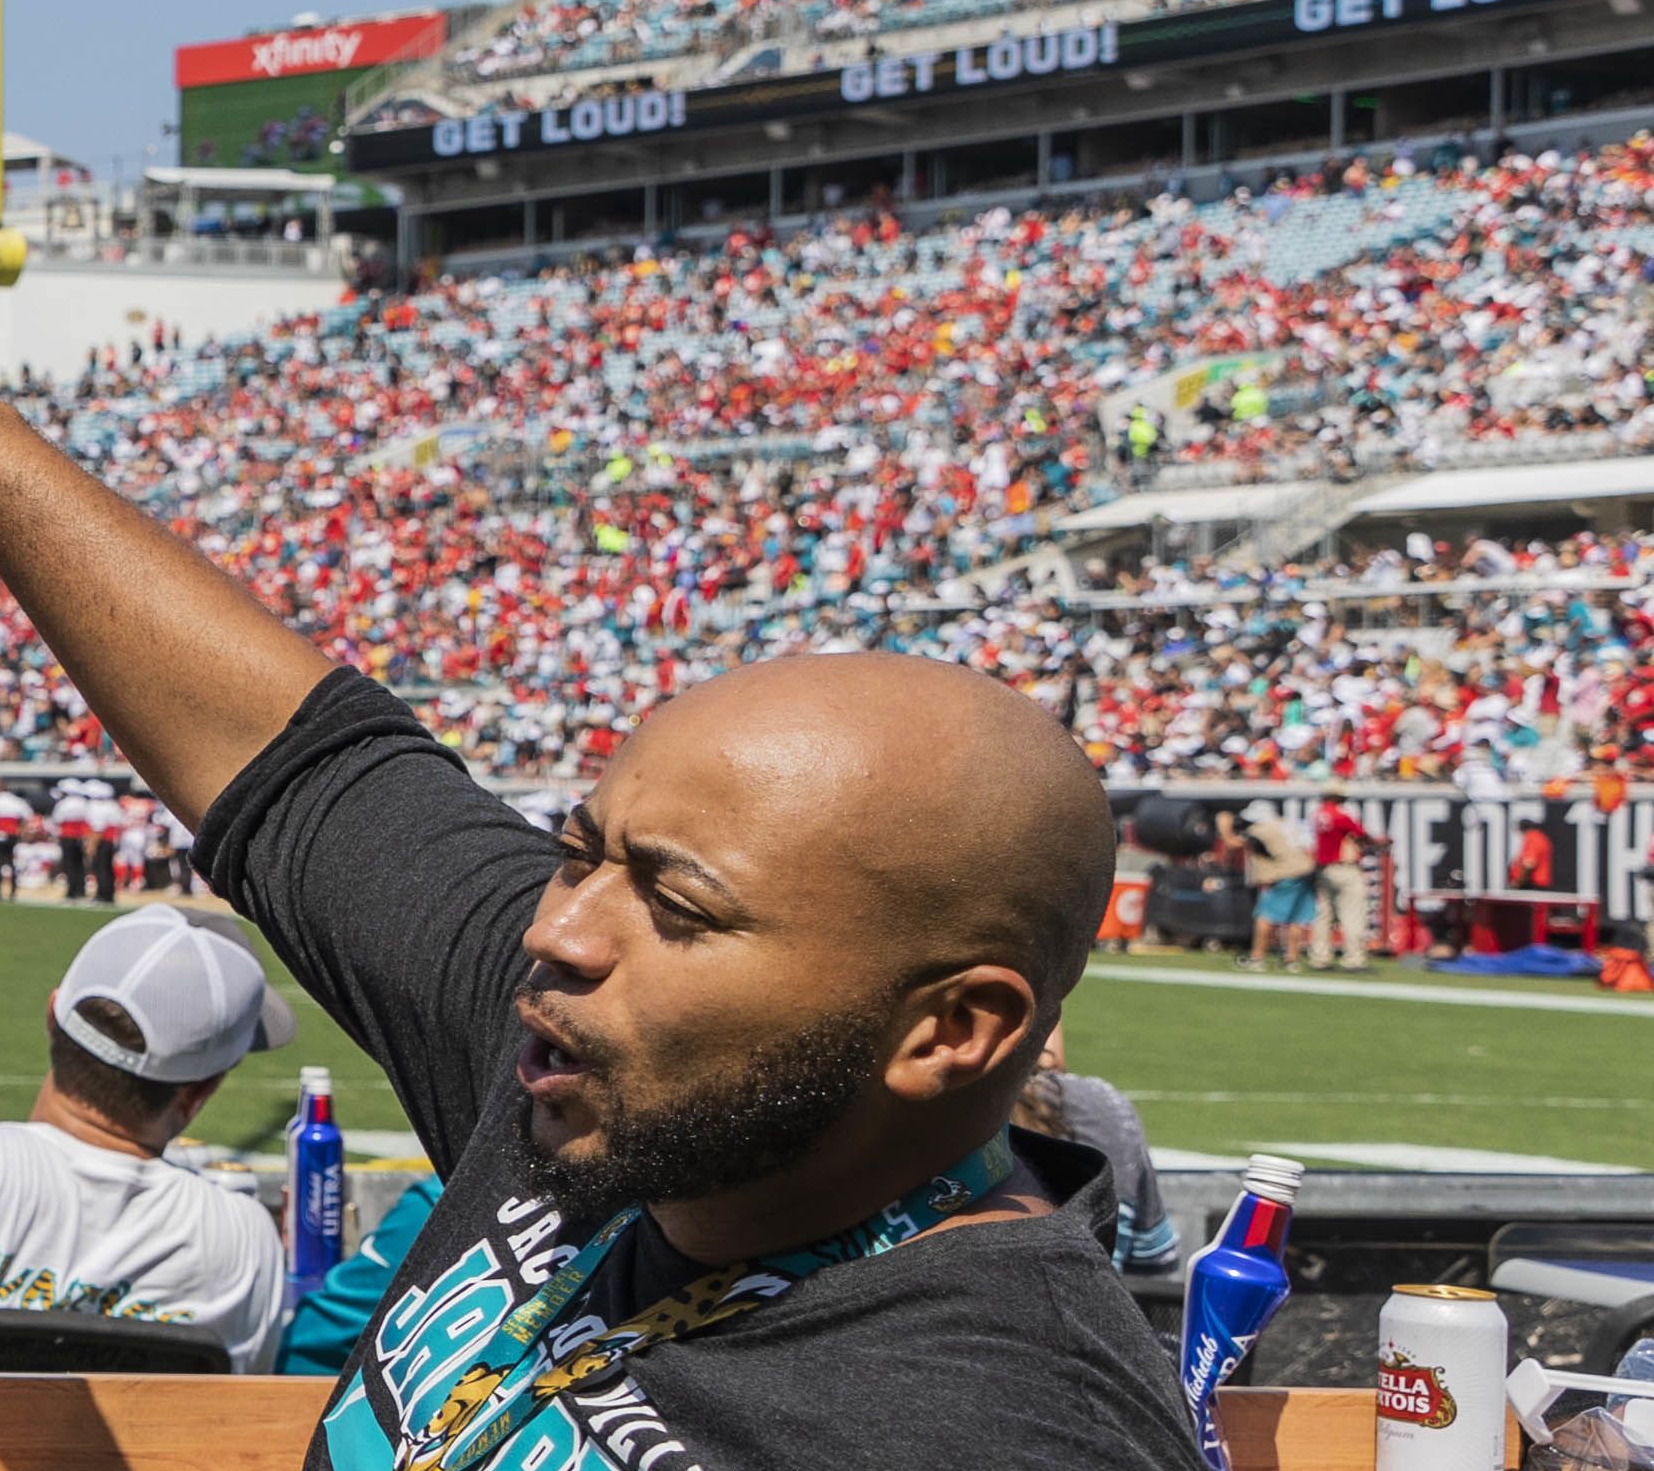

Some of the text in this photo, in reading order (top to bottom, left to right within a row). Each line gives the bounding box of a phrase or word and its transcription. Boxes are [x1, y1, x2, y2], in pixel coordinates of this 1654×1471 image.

[252, 28, 362, 76] xfinity
[840, 22, 1120, 102] GET LOUD!
[432, 92, 687, 157] GET LOUD!
[322, 1162, 339, 1236] ULTRA
[512, 1268, 586, 1346] MEMBER
[1376, 1371, 1430, 1397] TELLA
[1376, 1392, 1431, 1415] RTOIS
